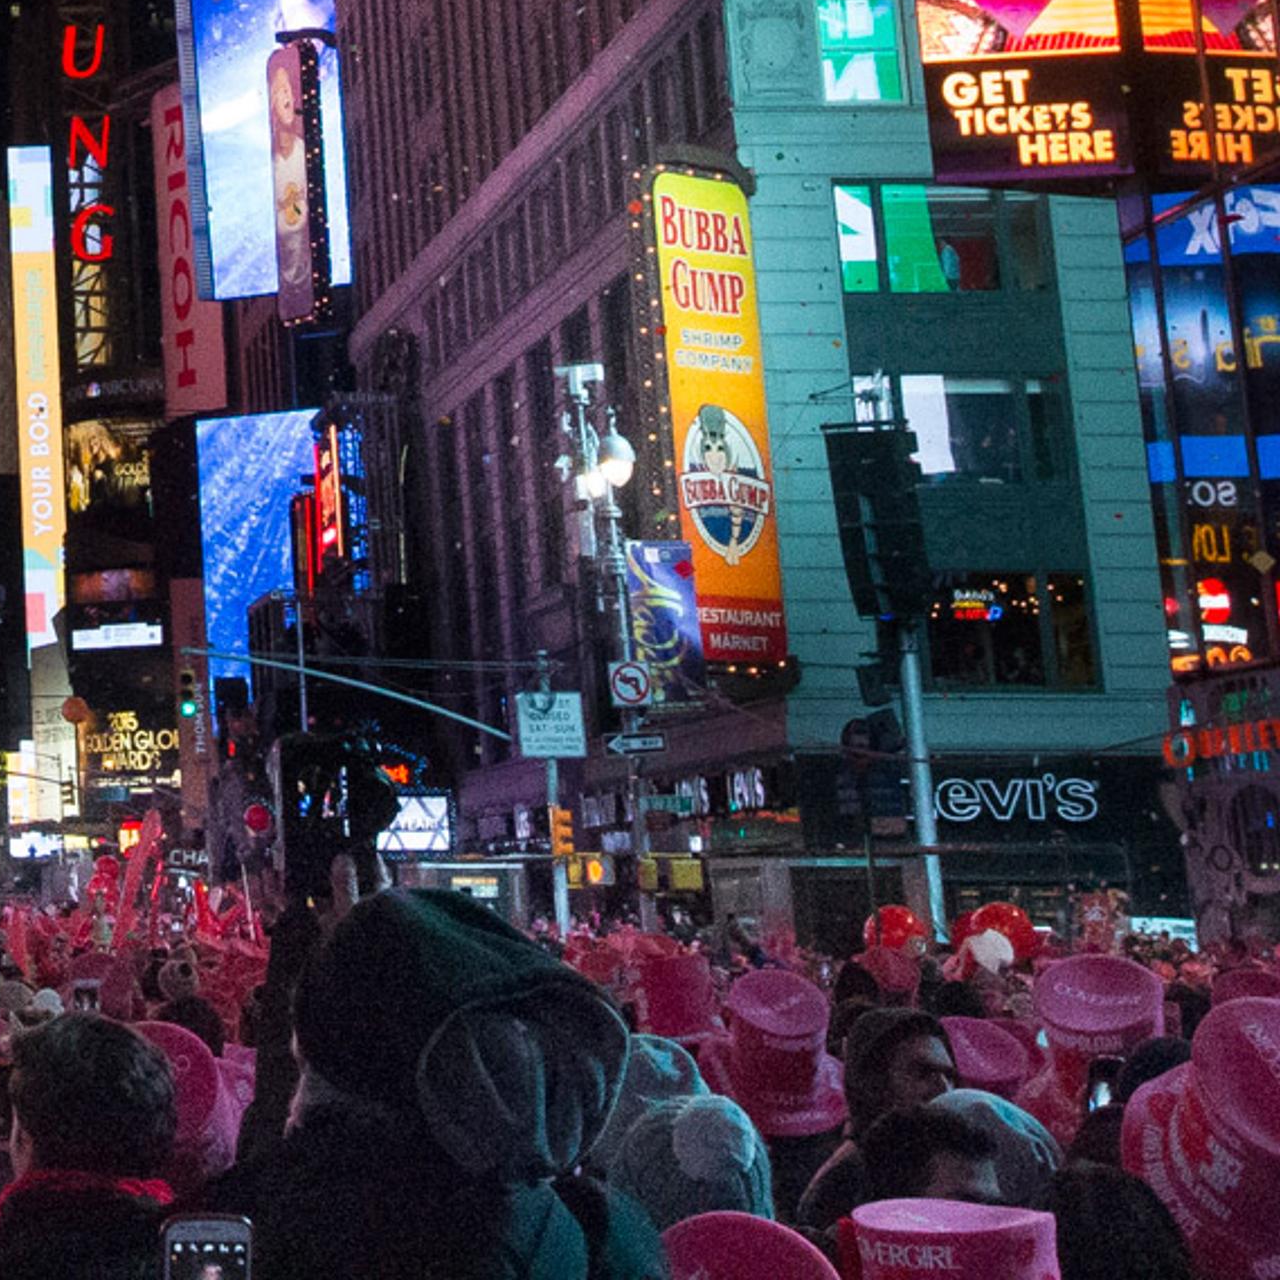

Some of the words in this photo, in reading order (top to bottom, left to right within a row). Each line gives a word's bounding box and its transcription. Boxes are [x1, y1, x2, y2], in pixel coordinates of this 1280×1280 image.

[942, 68, 1030, 108] GET
[953, 101, 1093, 138] TICKETS
[1018, 130, 1115, 167] HERE
[164, 105, 197, 388] RICOH
[660, 195, 748, 256] BUBBA
[671, 260, 745, 315] GUMP
[676, 349, 754, 373] COMPANY
[681, 328, 744, 350] SHRIMP
[27, 392, 50, 457] BOLD
[31, 464, 54, 537] YOUR
[709, 632, 768, 652] MARKET
[918, 772, 1098, 822] evi's
